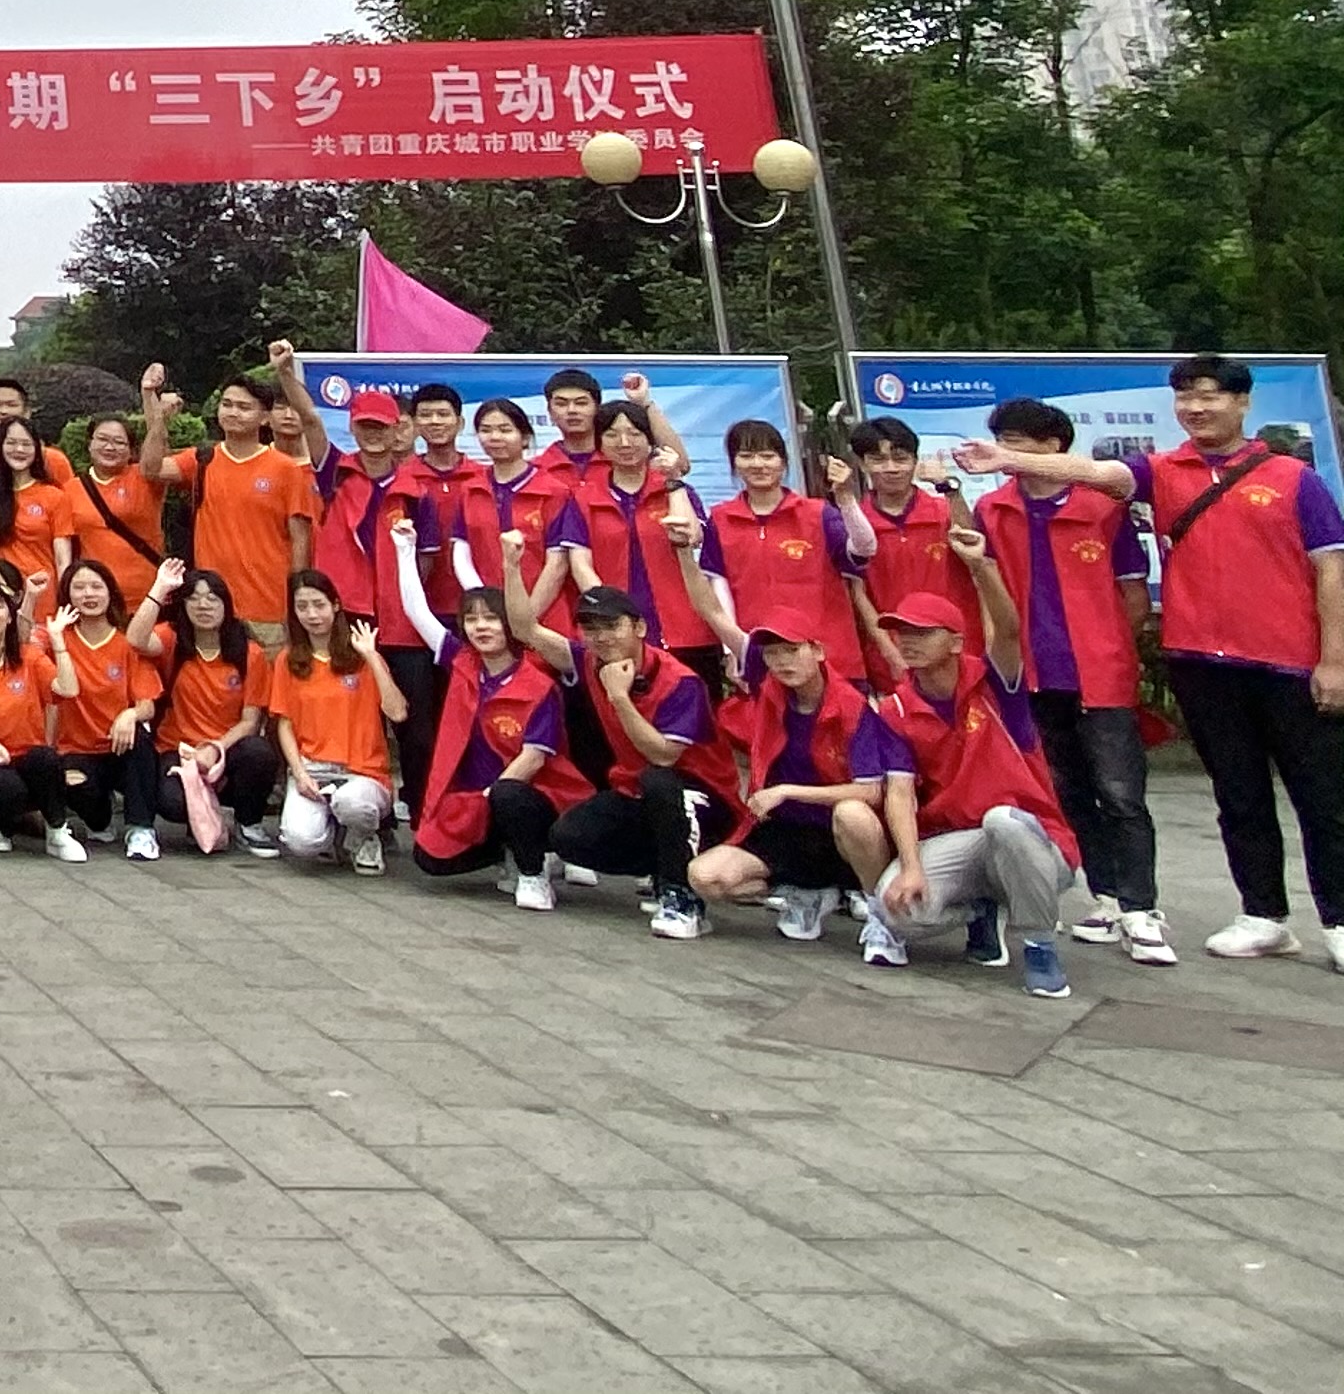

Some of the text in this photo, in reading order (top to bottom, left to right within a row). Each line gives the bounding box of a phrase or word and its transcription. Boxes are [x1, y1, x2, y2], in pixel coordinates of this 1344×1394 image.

[252, 127, 705, 156] ——共青团重庆城市职业学委员会
